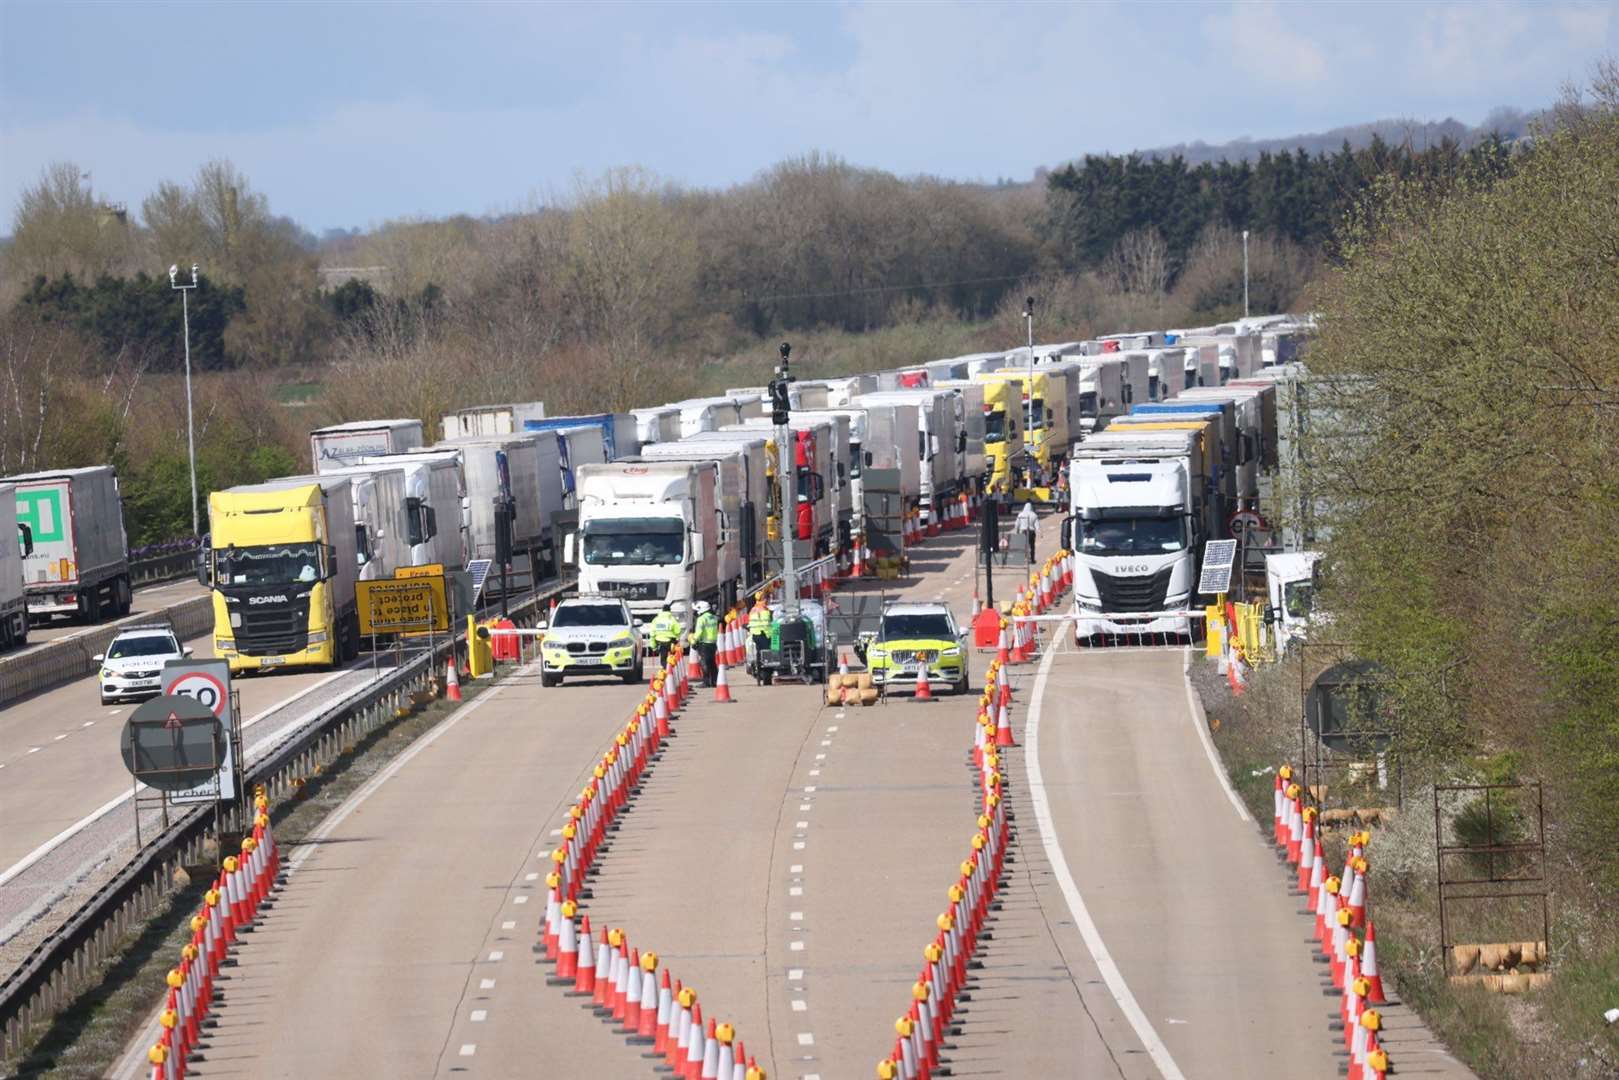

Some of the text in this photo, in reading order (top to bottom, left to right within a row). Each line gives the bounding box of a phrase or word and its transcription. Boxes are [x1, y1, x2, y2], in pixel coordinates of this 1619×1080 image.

[1115, 564, 1149, 573] IVECO
[249, 594, 289, 605] SCANIA
[380, 592, 423, 604] protect
[387, 604, 419, 614] place
[121, 659, 161, 668] POLICE
